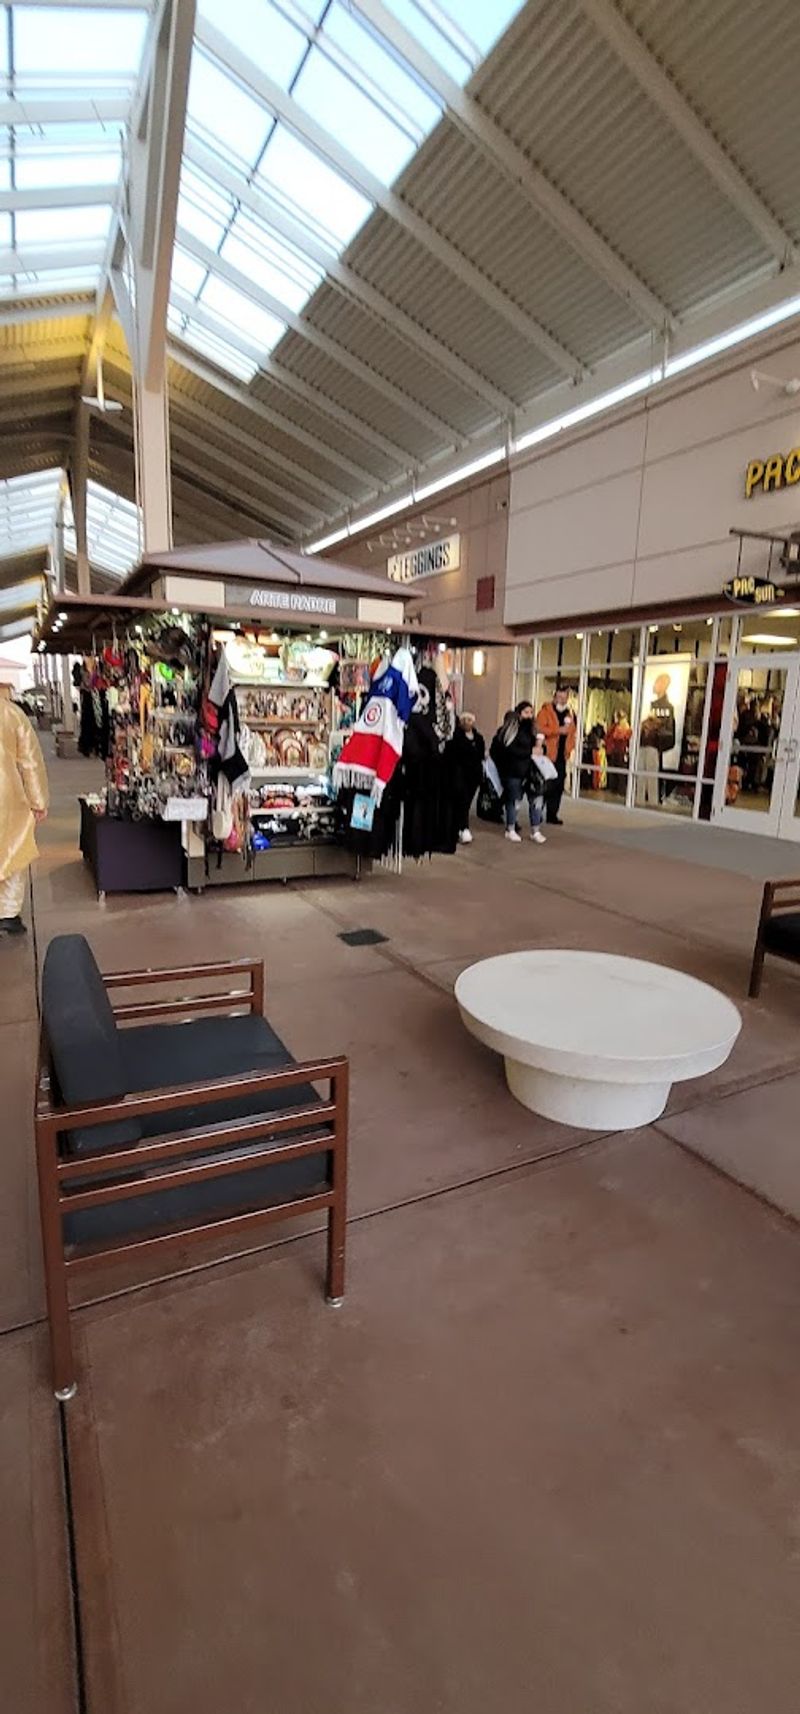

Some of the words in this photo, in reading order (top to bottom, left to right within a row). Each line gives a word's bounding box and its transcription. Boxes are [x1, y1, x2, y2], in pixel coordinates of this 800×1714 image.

[400, 542, 451, 580] LEGGINGS
[734, 577, 755, 597] PAC
[250, 590, 290, 609] ARTE
